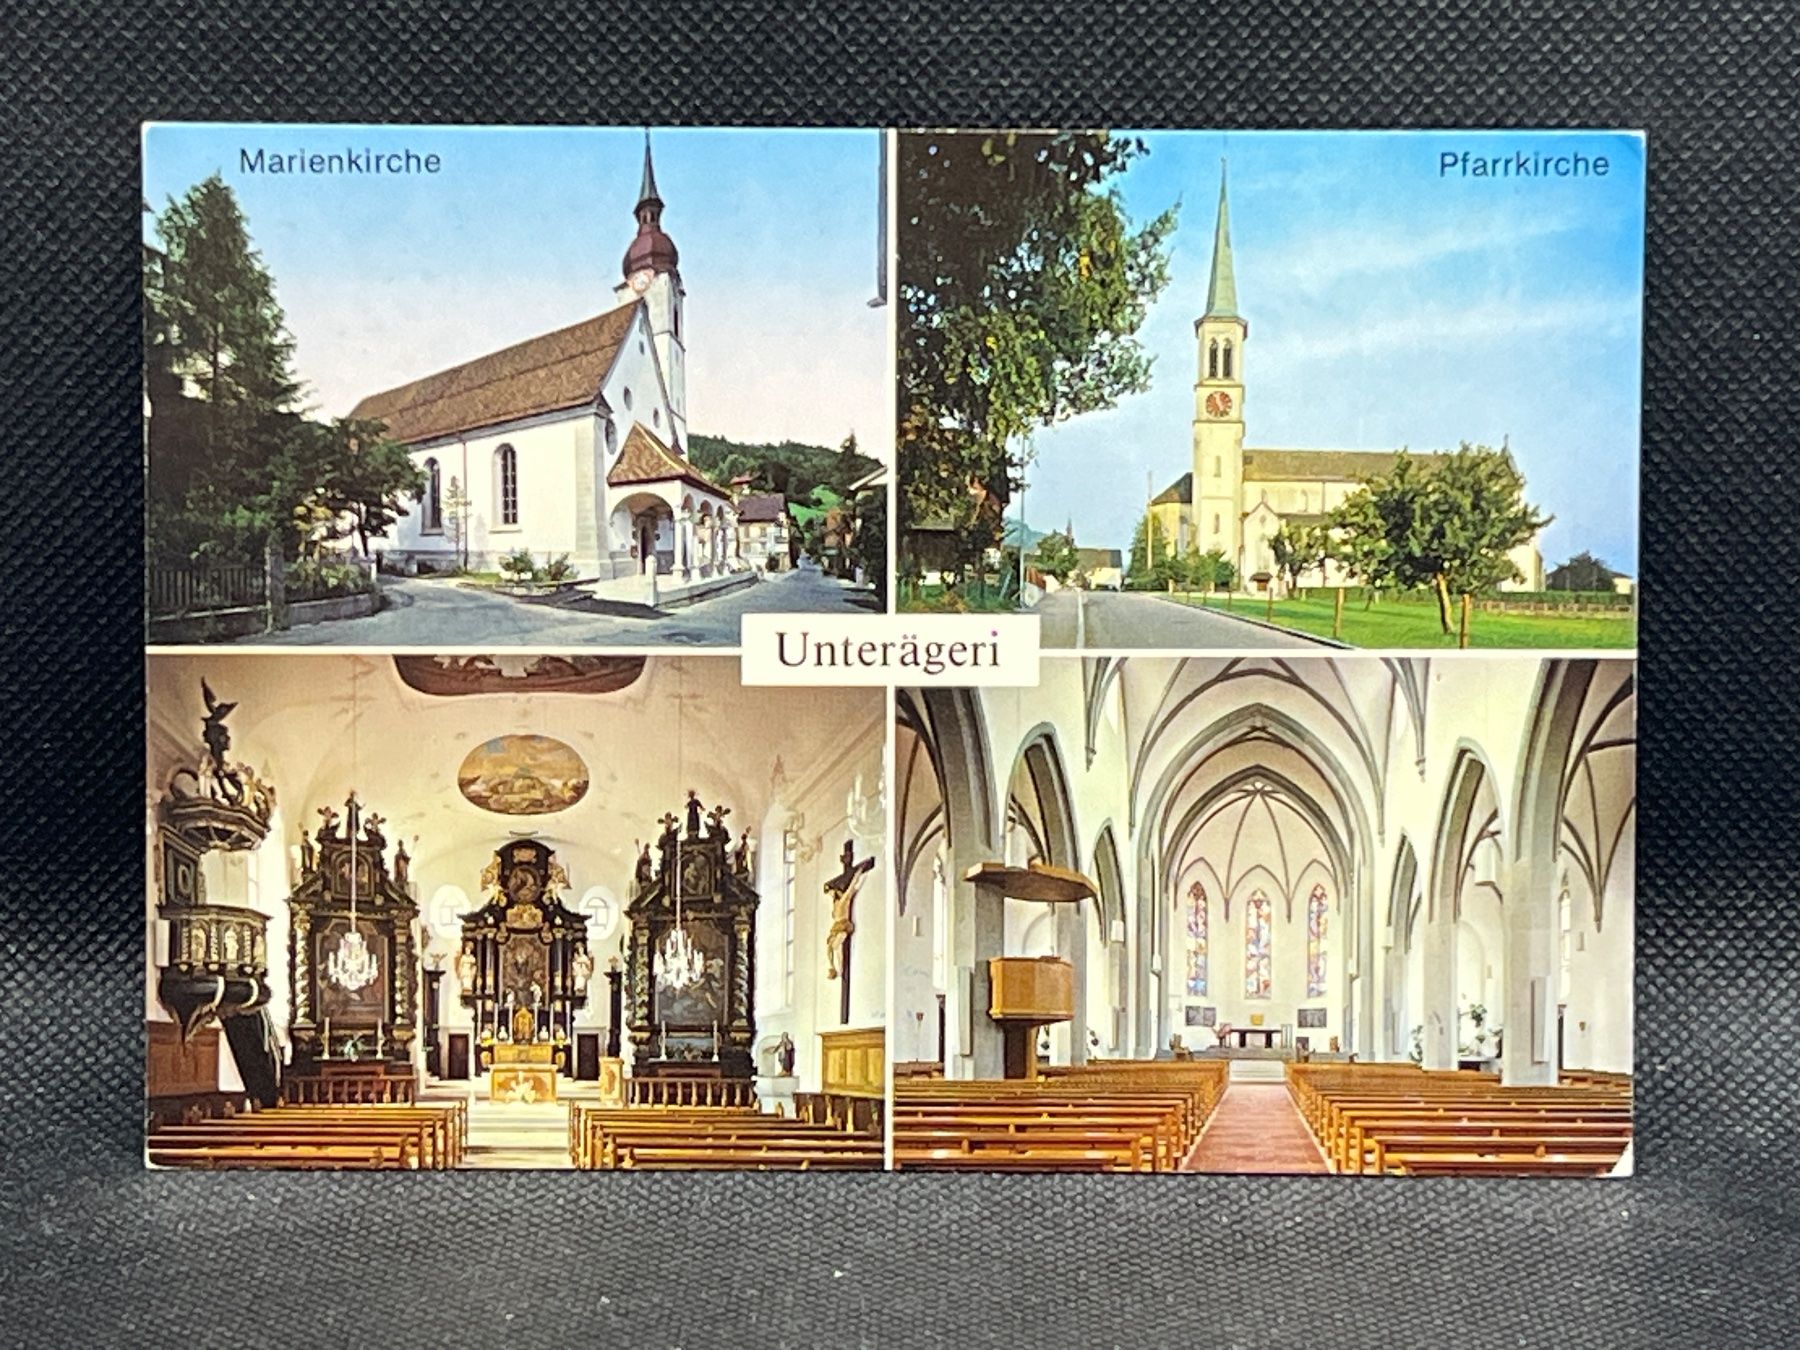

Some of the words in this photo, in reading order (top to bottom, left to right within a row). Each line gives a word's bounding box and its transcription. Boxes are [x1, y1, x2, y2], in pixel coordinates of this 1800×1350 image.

[241, 148, 441, 174] Marienkirche
[1441, 151, 1609, 177] Pfarrkirche
[776, 631, 1000, 675] Unterägeri
